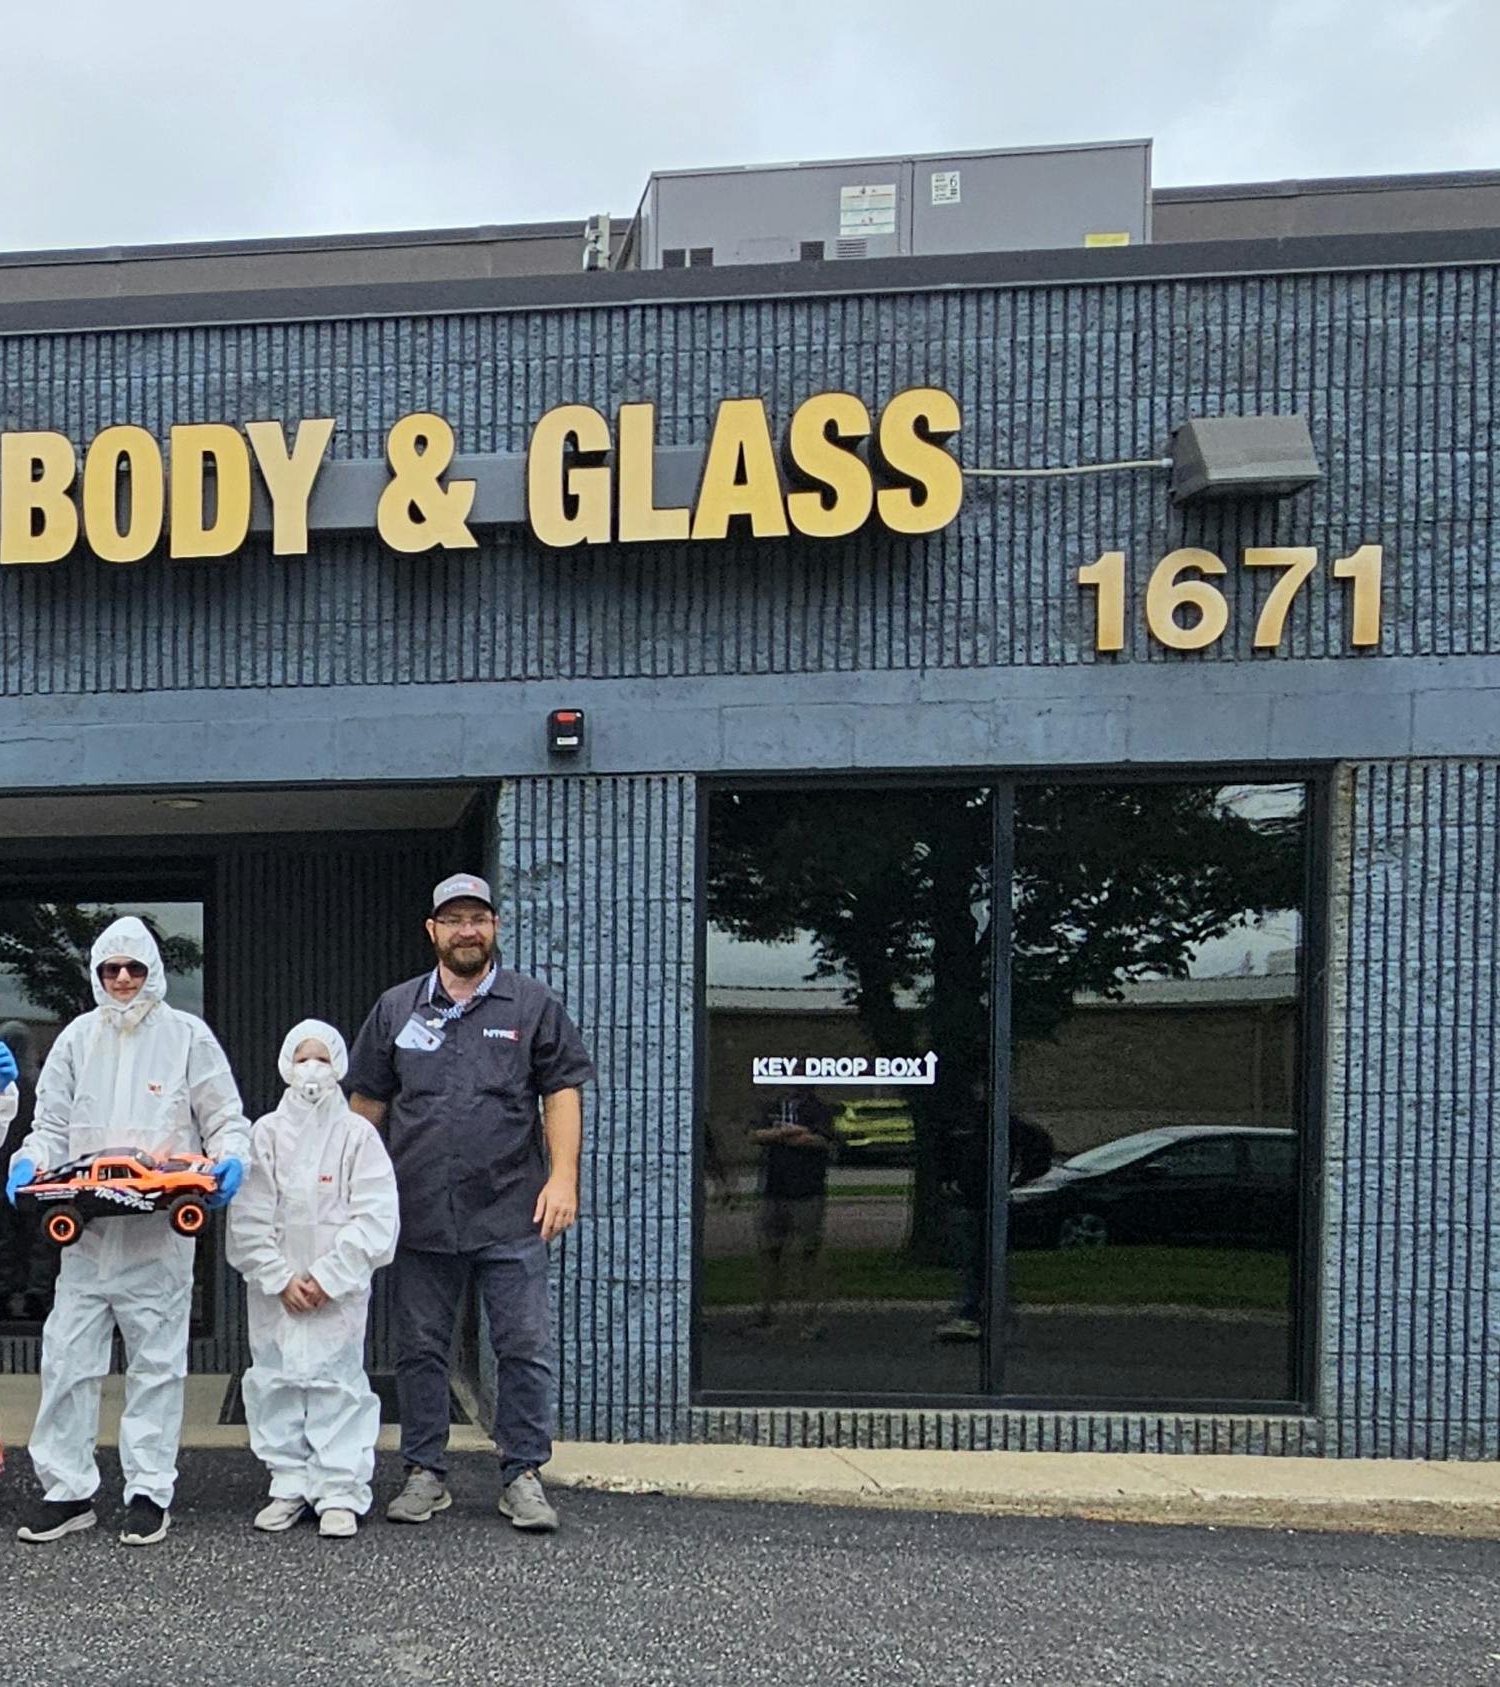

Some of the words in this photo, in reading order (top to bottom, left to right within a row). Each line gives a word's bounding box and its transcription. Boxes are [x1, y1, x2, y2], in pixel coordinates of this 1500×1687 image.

[376, 413, 479, 553] &
[526, 388, 963, 547] GLASS
[1078, 544, 1383, 651] 1671
[753, 1056, 798, 1076] KEY
[805, 1056, 868, 1077] DROP
[875, 1056, 922, 1077] BOX
